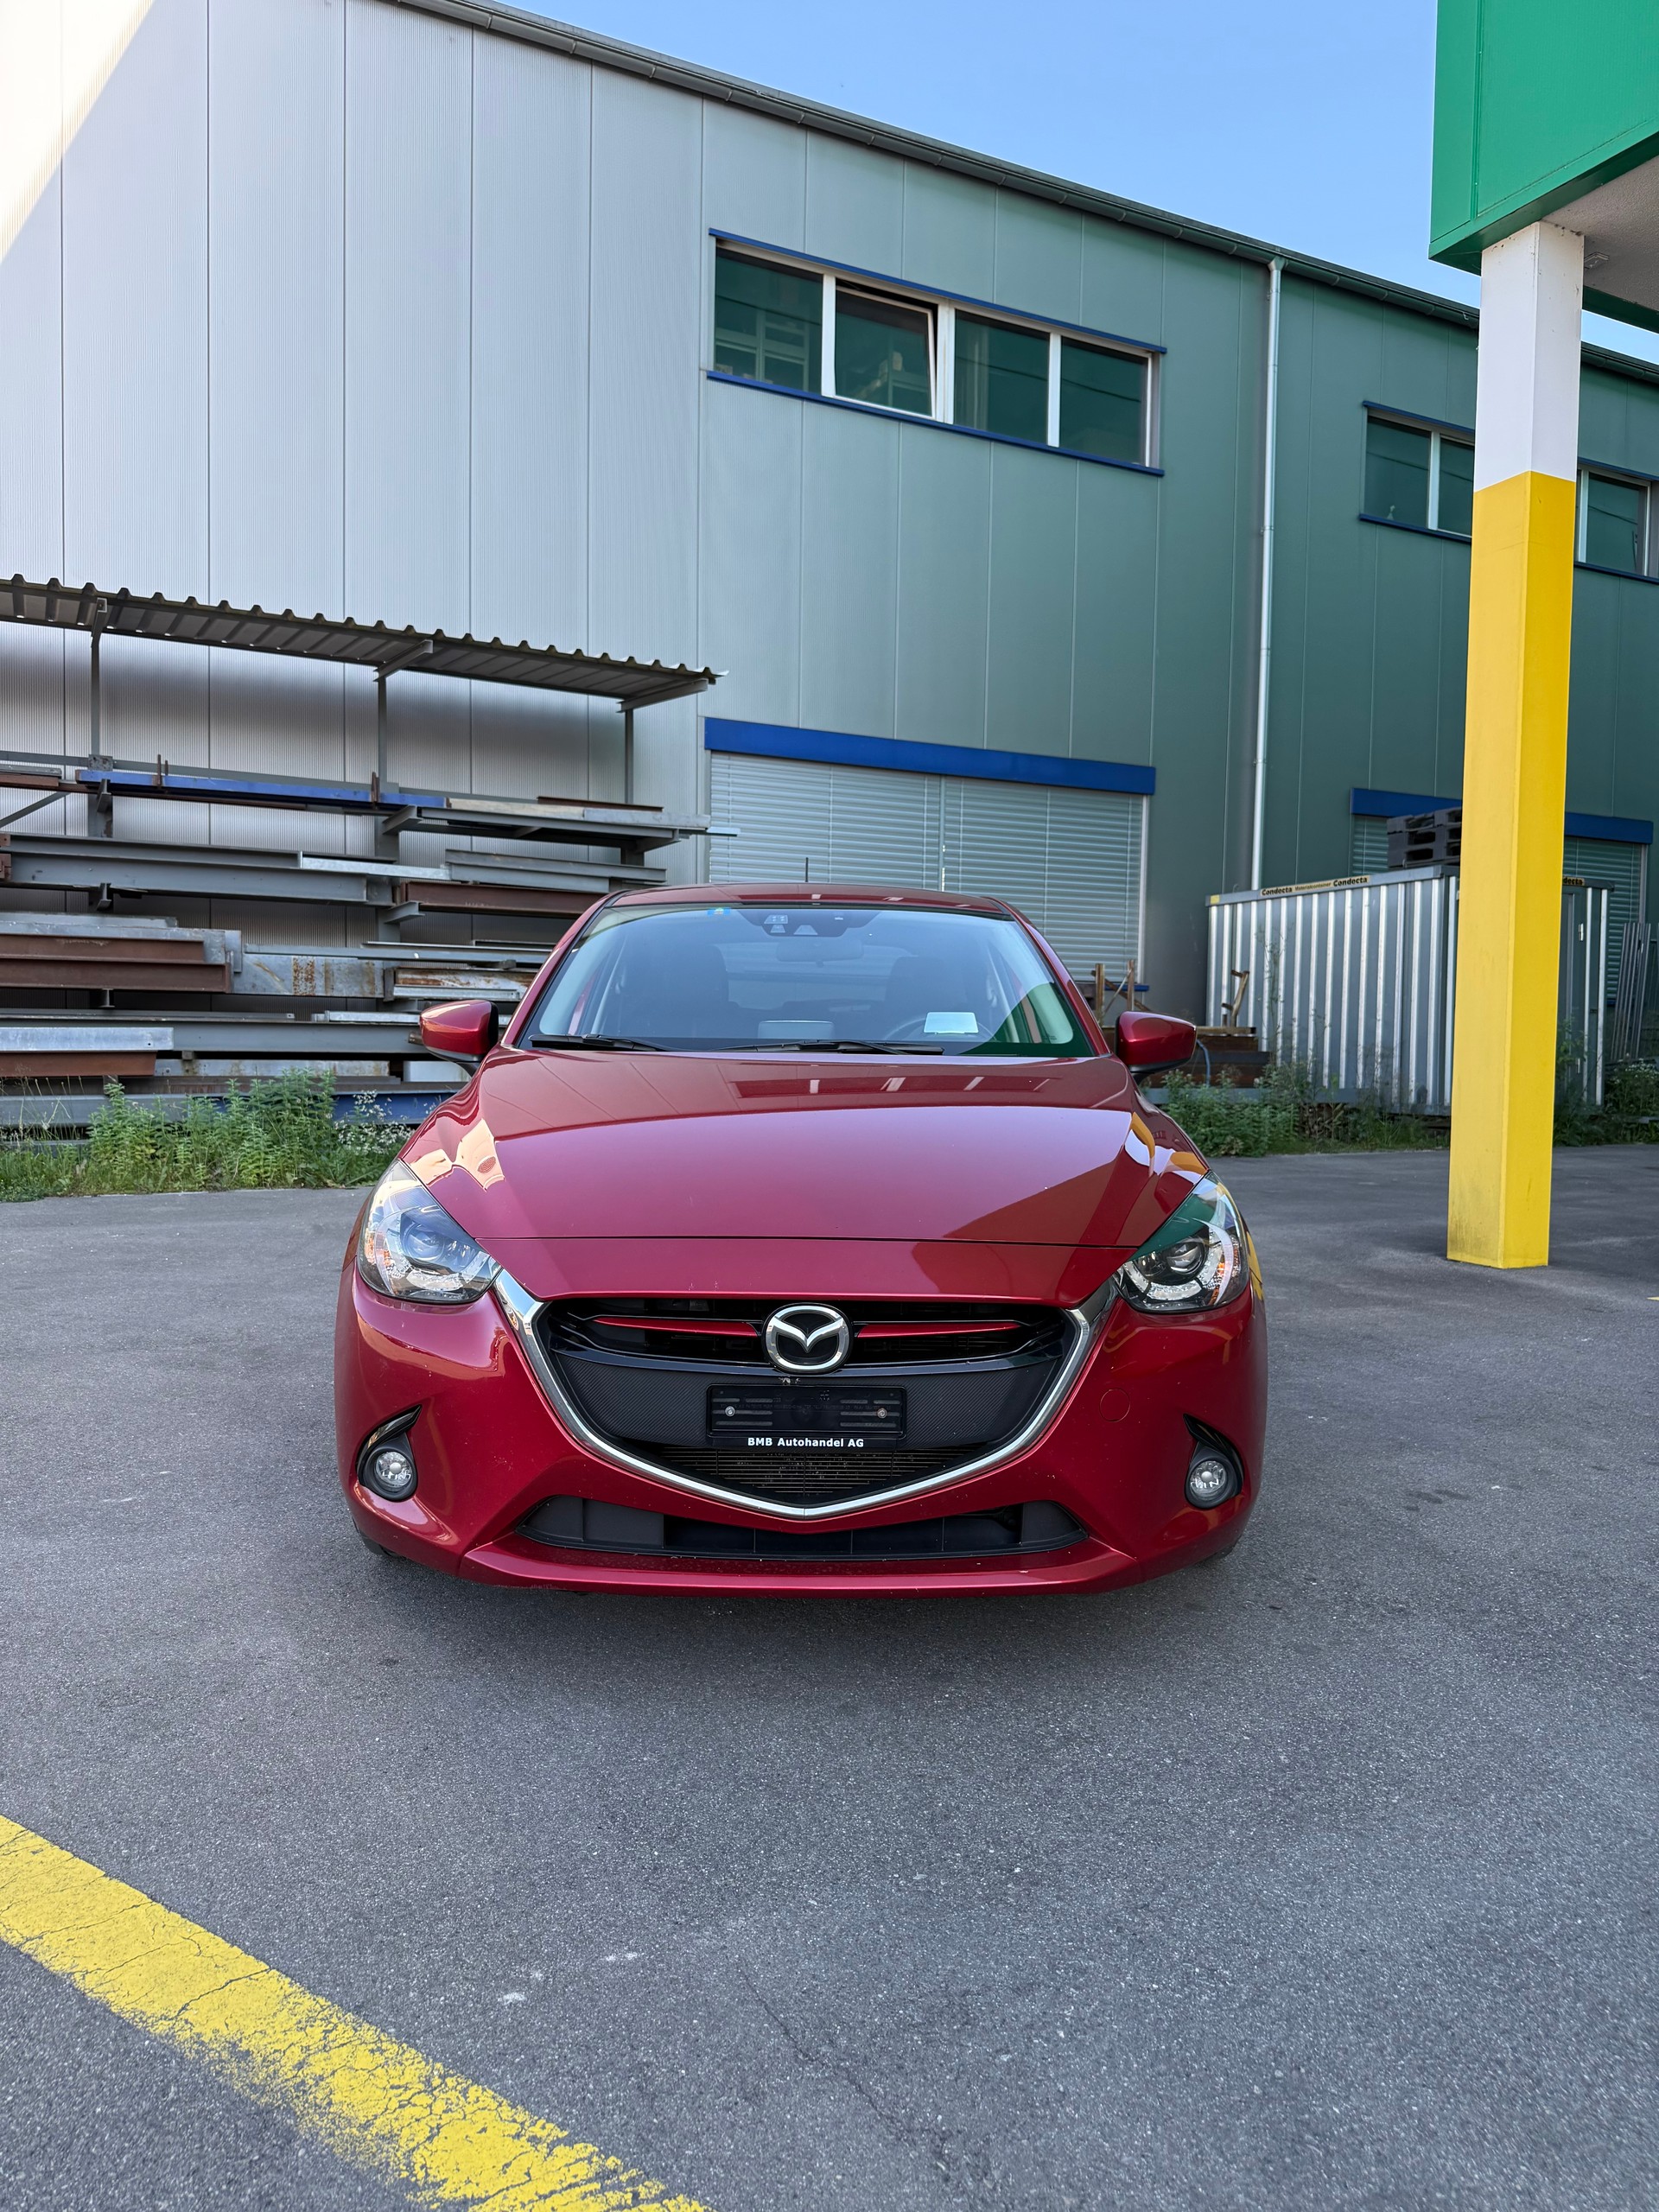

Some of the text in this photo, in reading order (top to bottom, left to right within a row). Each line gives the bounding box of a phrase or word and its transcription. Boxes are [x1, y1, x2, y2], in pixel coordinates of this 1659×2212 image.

[1262, 887, 1293, 896] Condecta
[1333, 877, 1368, 887] Condecta
[1563, 877, 1583, 886] decta
[747, 1437, 864, 1447] BMB Autohandel AG
